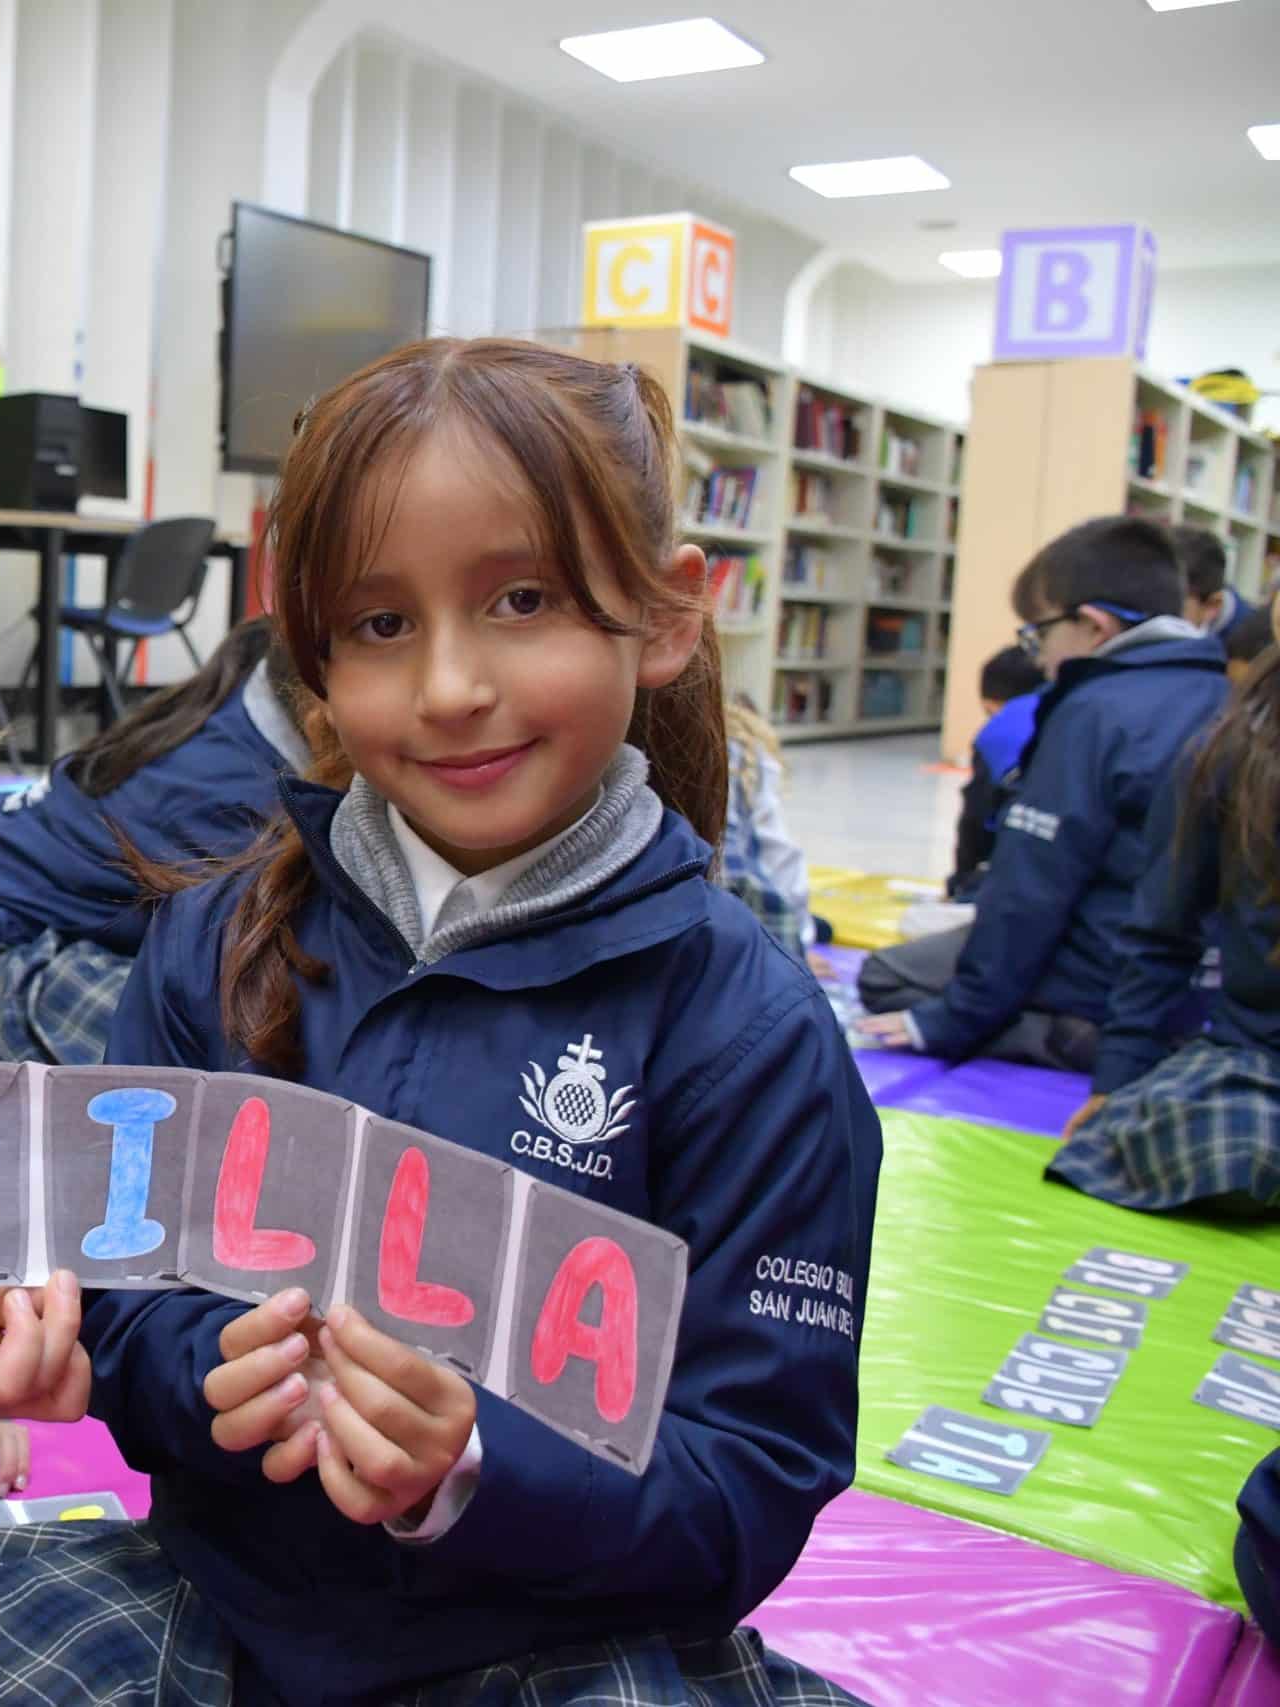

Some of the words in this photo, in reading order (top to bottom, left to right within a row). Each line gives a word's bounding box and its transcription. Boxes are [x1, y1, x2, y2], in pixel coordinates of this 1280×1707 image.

[607, 243, 654, 311] C
[702, 248, 720, 316] C
[1033, 249, 1093, 334] B
[510, 1130, 613, 1181] C.B.S.J.D.
[756, 1255, 833, 1291] COLEGIO
[749, 1290, 791, 1321] SAN
[795, 1297, 838, 1331] JUAN
